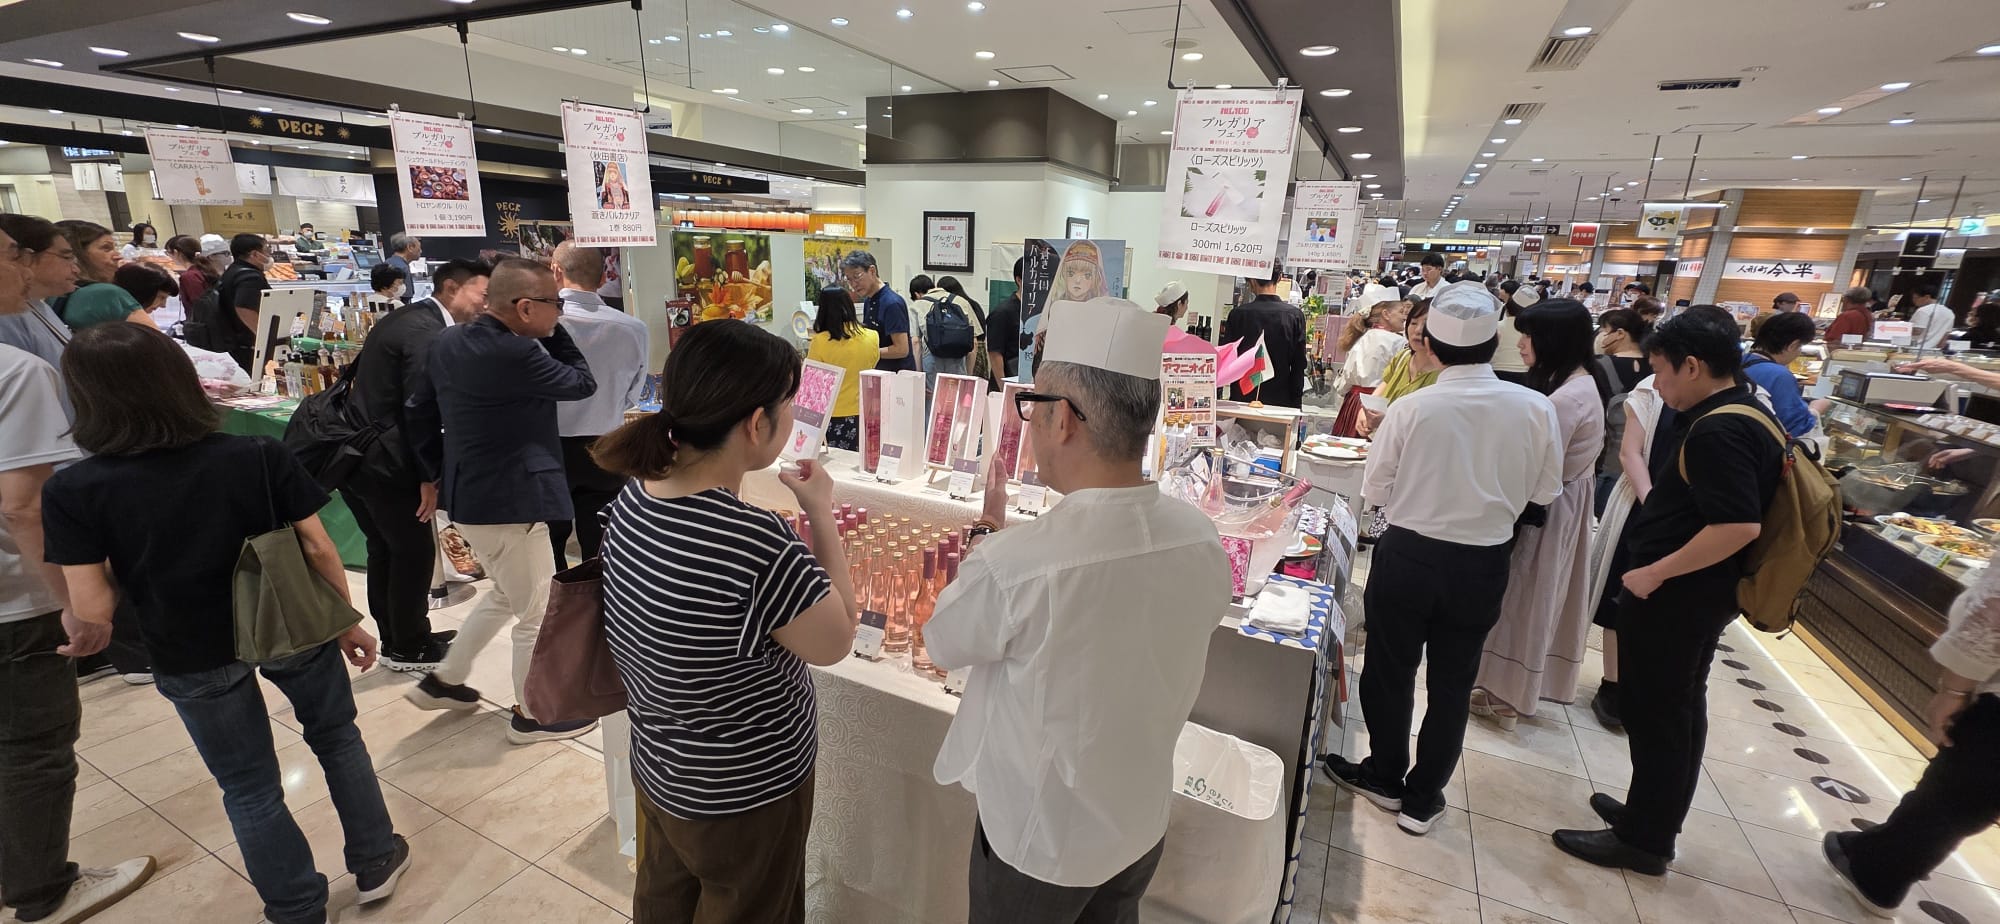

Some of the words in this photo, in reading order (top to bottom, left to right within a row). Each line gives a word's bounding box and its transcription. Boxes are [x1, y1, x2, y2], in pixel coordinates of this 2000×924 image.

[277, 119, 325, 137] PECK
[583, 122, 627, 135] ブルガリア
[1201, 116, 1266, 130] ブルガリア
[411, 131, 455, 143] ブルガリア
[596, 132, 617, 141] フェア
[1217, 129, 1246, 139] フェア
[425, 139, 445, 148] フェア
[702, 174, 722, 186] PECK
[495, 202, 521, 212] PECK
[1190, 222, 1248, 235] ローズスピリッツ
[932, 233, 964, 242] ブルガリア
[1191, 239, 1222, 251] 300ml
[1224, 242, 1263, 255] 1,620円
[1162, 363, 1216, 374] アマニオイル
